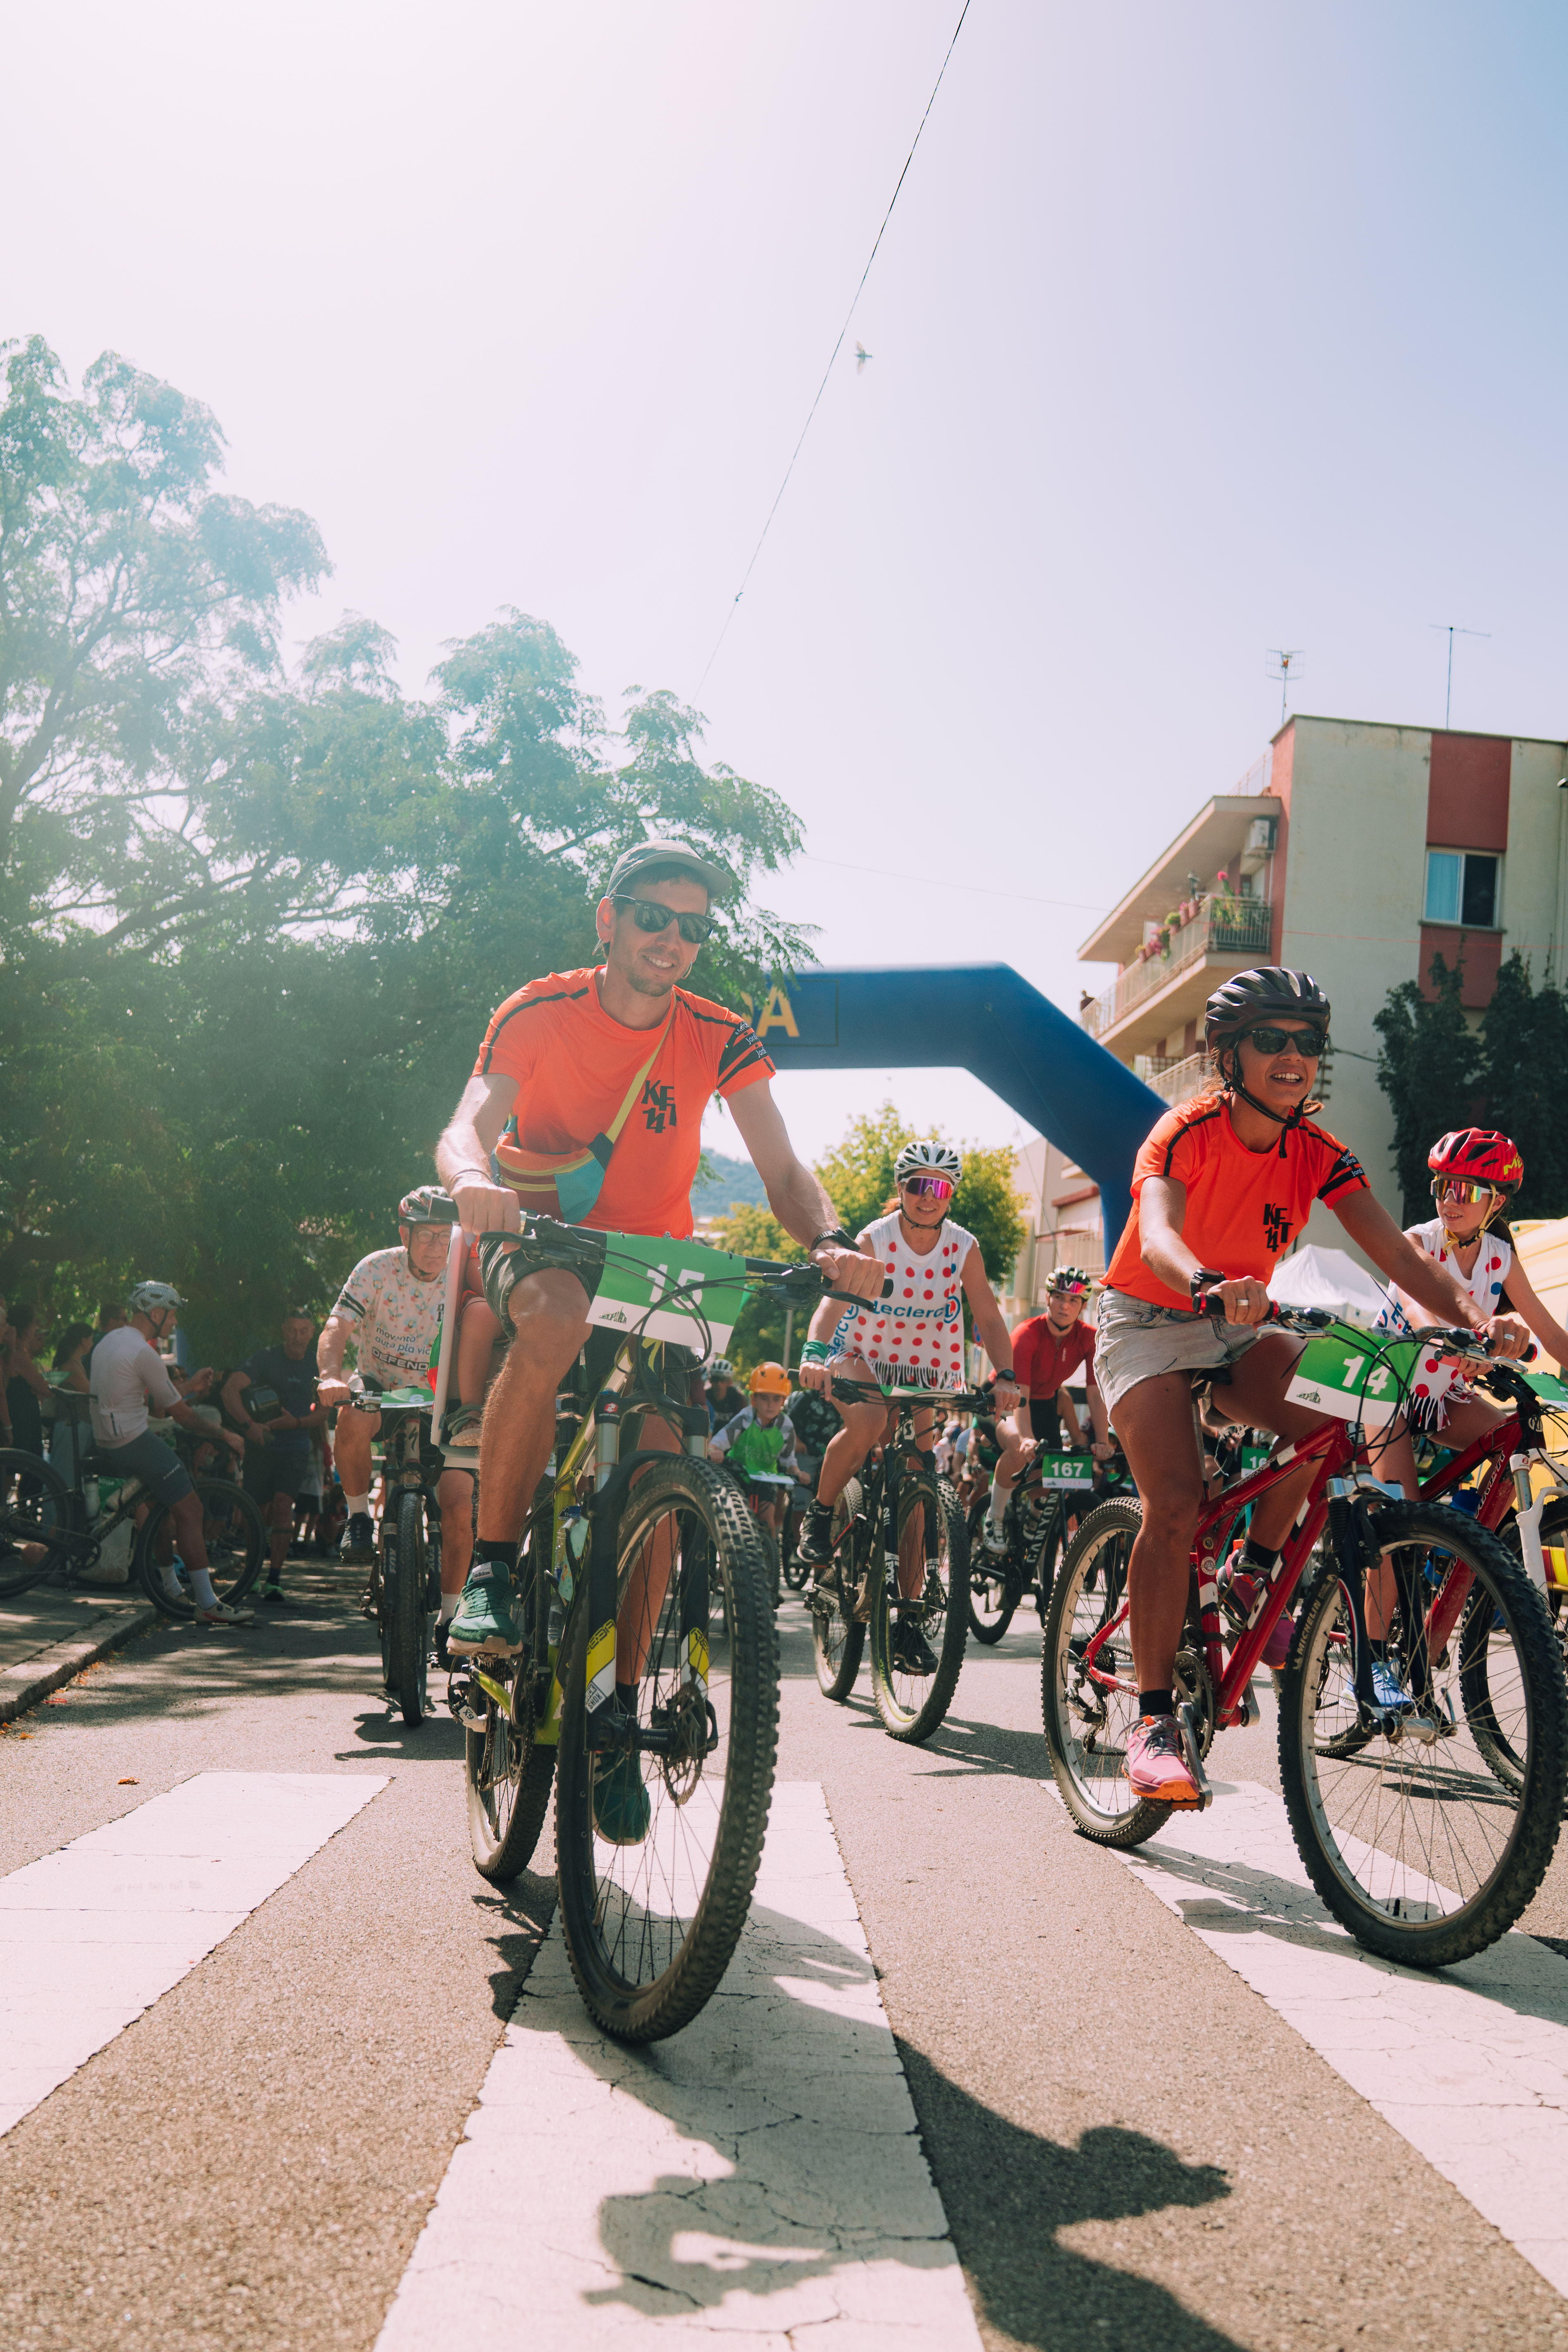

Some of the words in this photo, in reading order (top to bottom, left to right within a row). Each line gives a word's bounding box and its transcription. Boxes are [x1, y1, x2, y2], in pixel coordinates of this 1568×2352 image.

[1351, 1168, 1363, 1176] Jordi
[647, 1264, 705, 1309] 15
[872, 1300, 945, 1318] Leclerc
[376, 1327, 416, 1342] movento
[375, 1336, 395, 1348] auto
[397, 1344, 415, 1353] pla
[418, 1347, 430, 1355] vic
[373, 1347, 428, 1370] DEFEND
[1343, 1355, 1391, 1395] 14
[1051, 1462, 1084, 1477] 167
[1026, 1493, 1059, 1563] CANYON
[1297, 1599, 1320, 1656] MICHELIN
[588, 1693, 602, 1709] SHOX
